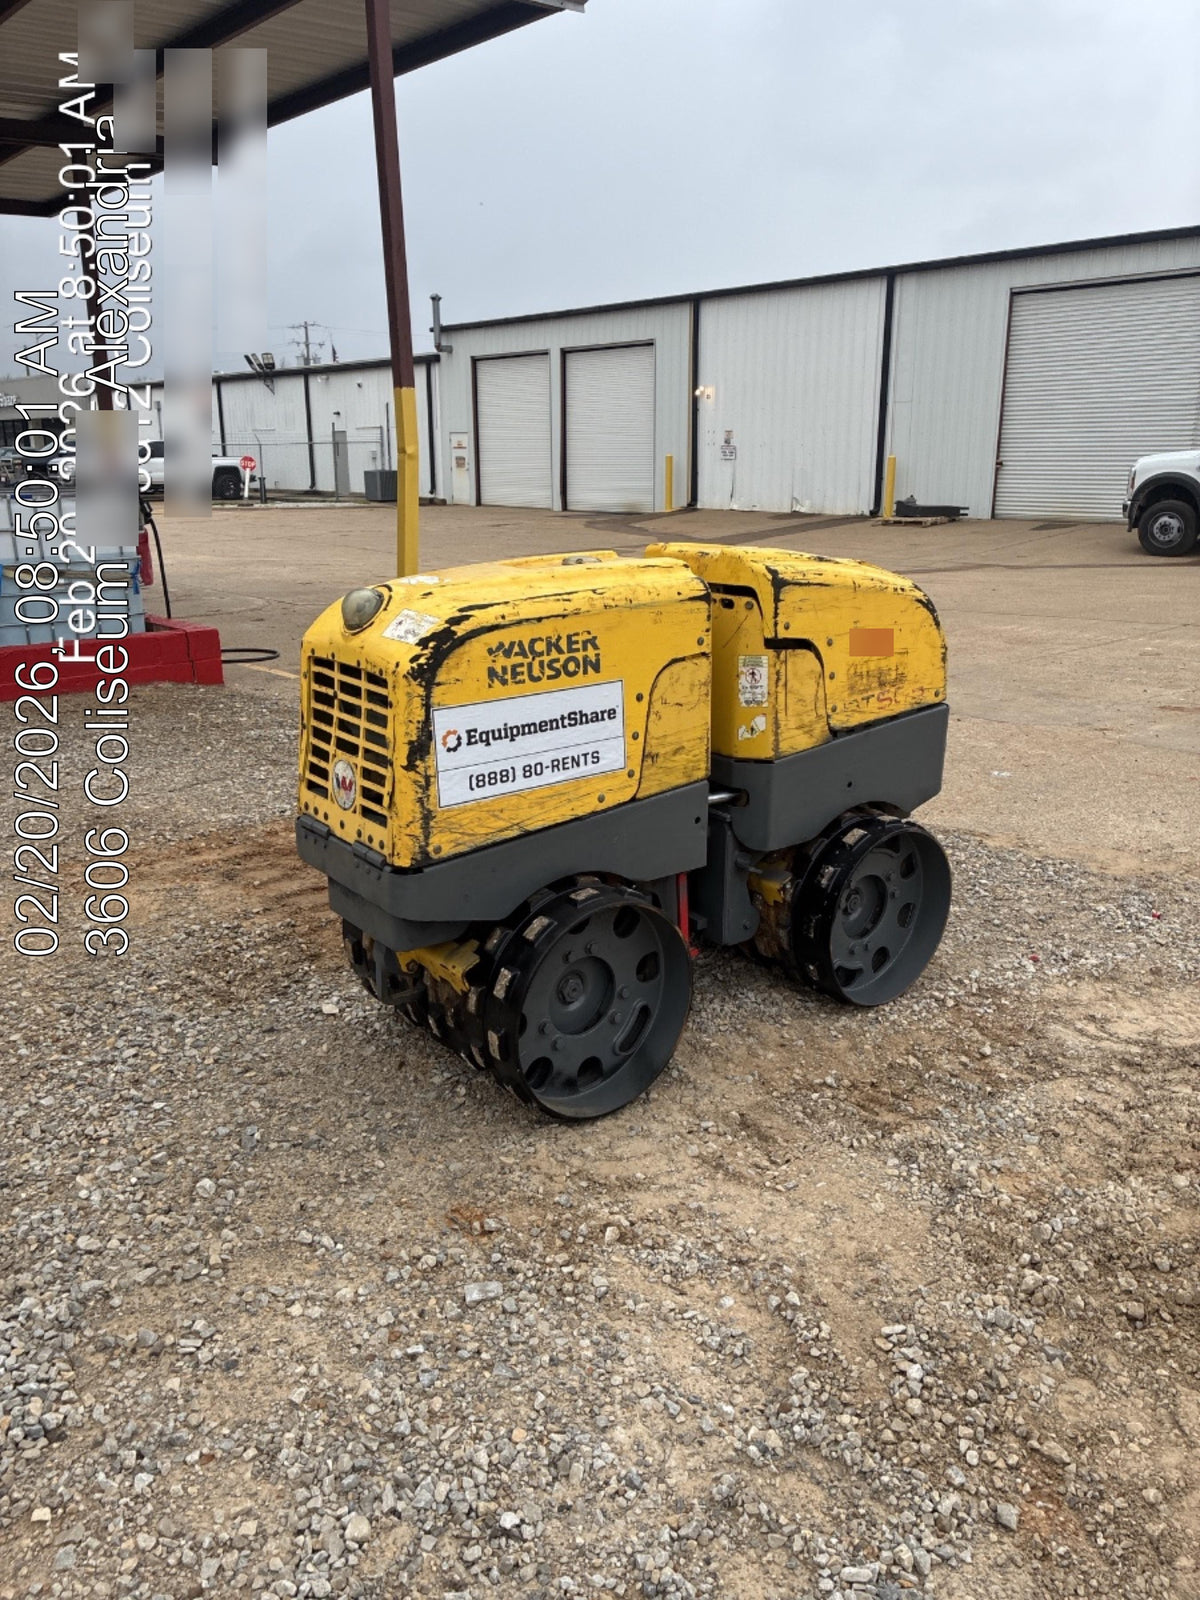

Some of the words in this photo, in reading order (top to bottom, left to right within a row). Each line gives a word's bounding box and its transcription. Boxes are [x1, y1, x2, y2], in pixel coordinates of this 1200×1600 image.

[486, 630, 601, 662] WACKER
[487, 653, 601, 688] NEUSON
[465, 707, 617, 746] EquipmentShare
[468, 767, 516, 791] (888)
[522, 750, 601, 779] 80-RENTS
